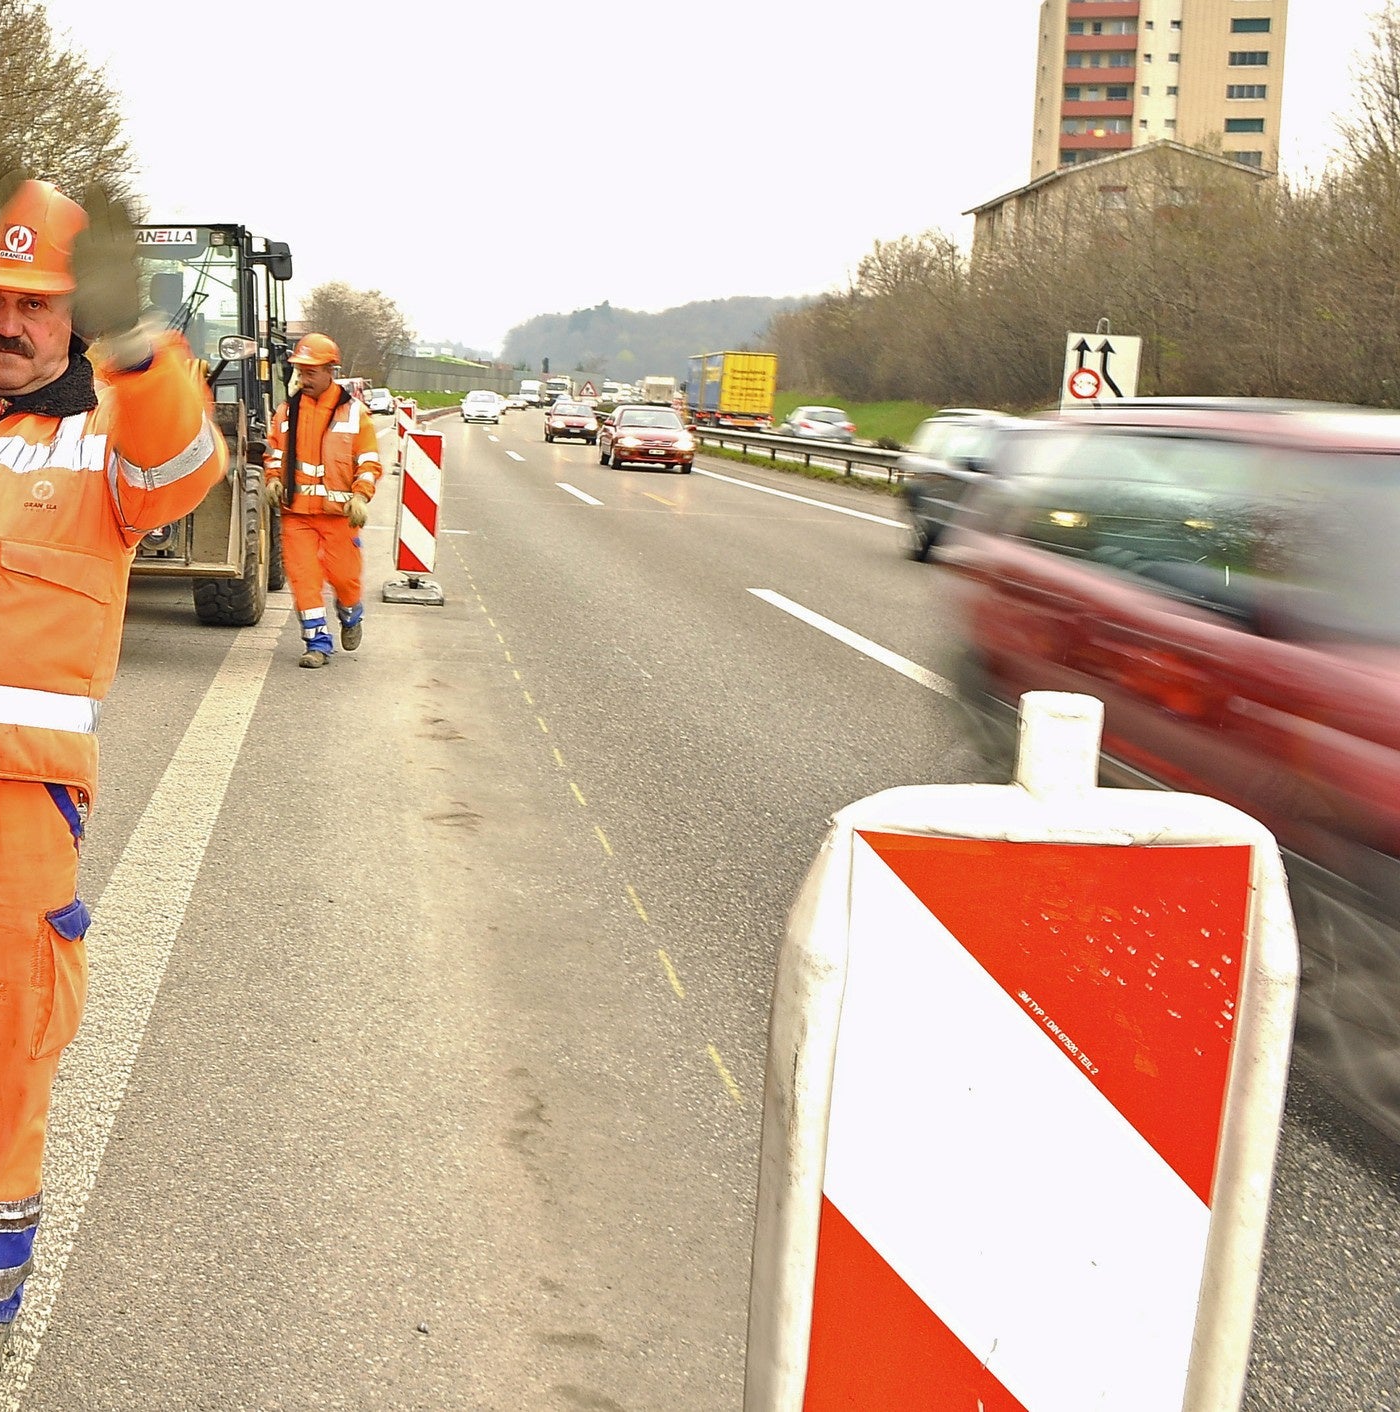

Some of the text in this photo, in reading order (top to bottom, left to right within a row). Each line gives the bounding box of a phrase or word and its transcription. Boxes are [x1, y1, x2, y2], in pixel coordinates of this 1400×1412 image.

[136, 231, 193, 243] ANELLA
[1018, 991, 1032, 1003] 3M
[1029, 1000, 1045, 1016] TYP
[1046, 1020, 1061, 1035] DIN
[1077, 1053, 1093, 1071] TEIL
